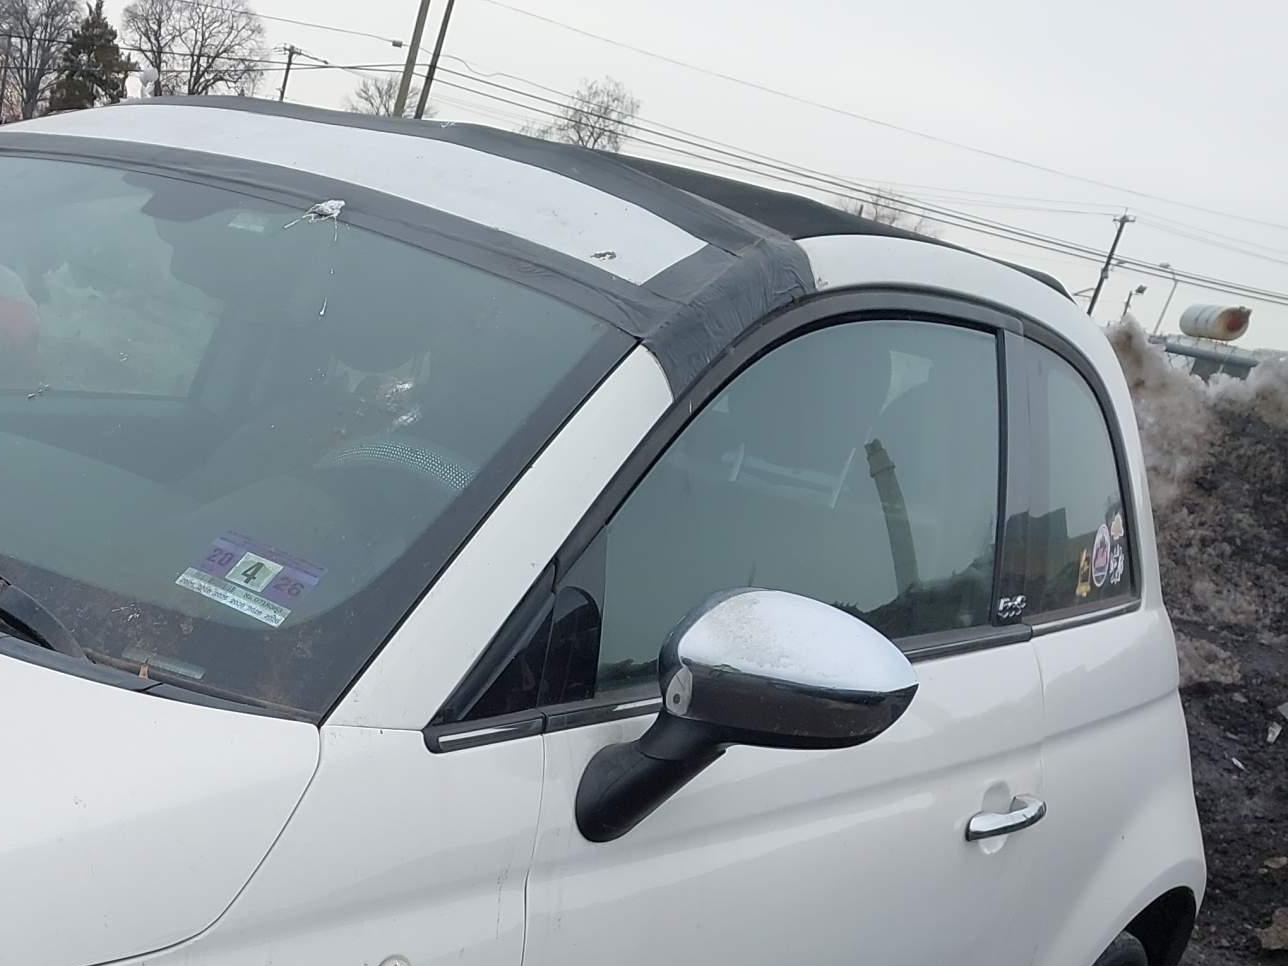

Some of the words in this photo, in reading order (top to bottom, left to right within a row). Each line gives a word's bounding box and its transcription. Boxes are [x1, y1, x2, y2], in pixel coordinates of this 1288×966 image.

[207, 547, 234, 567] 20
[240, 561, 265, 584] 4
[273, 576, 305, 597] 26
